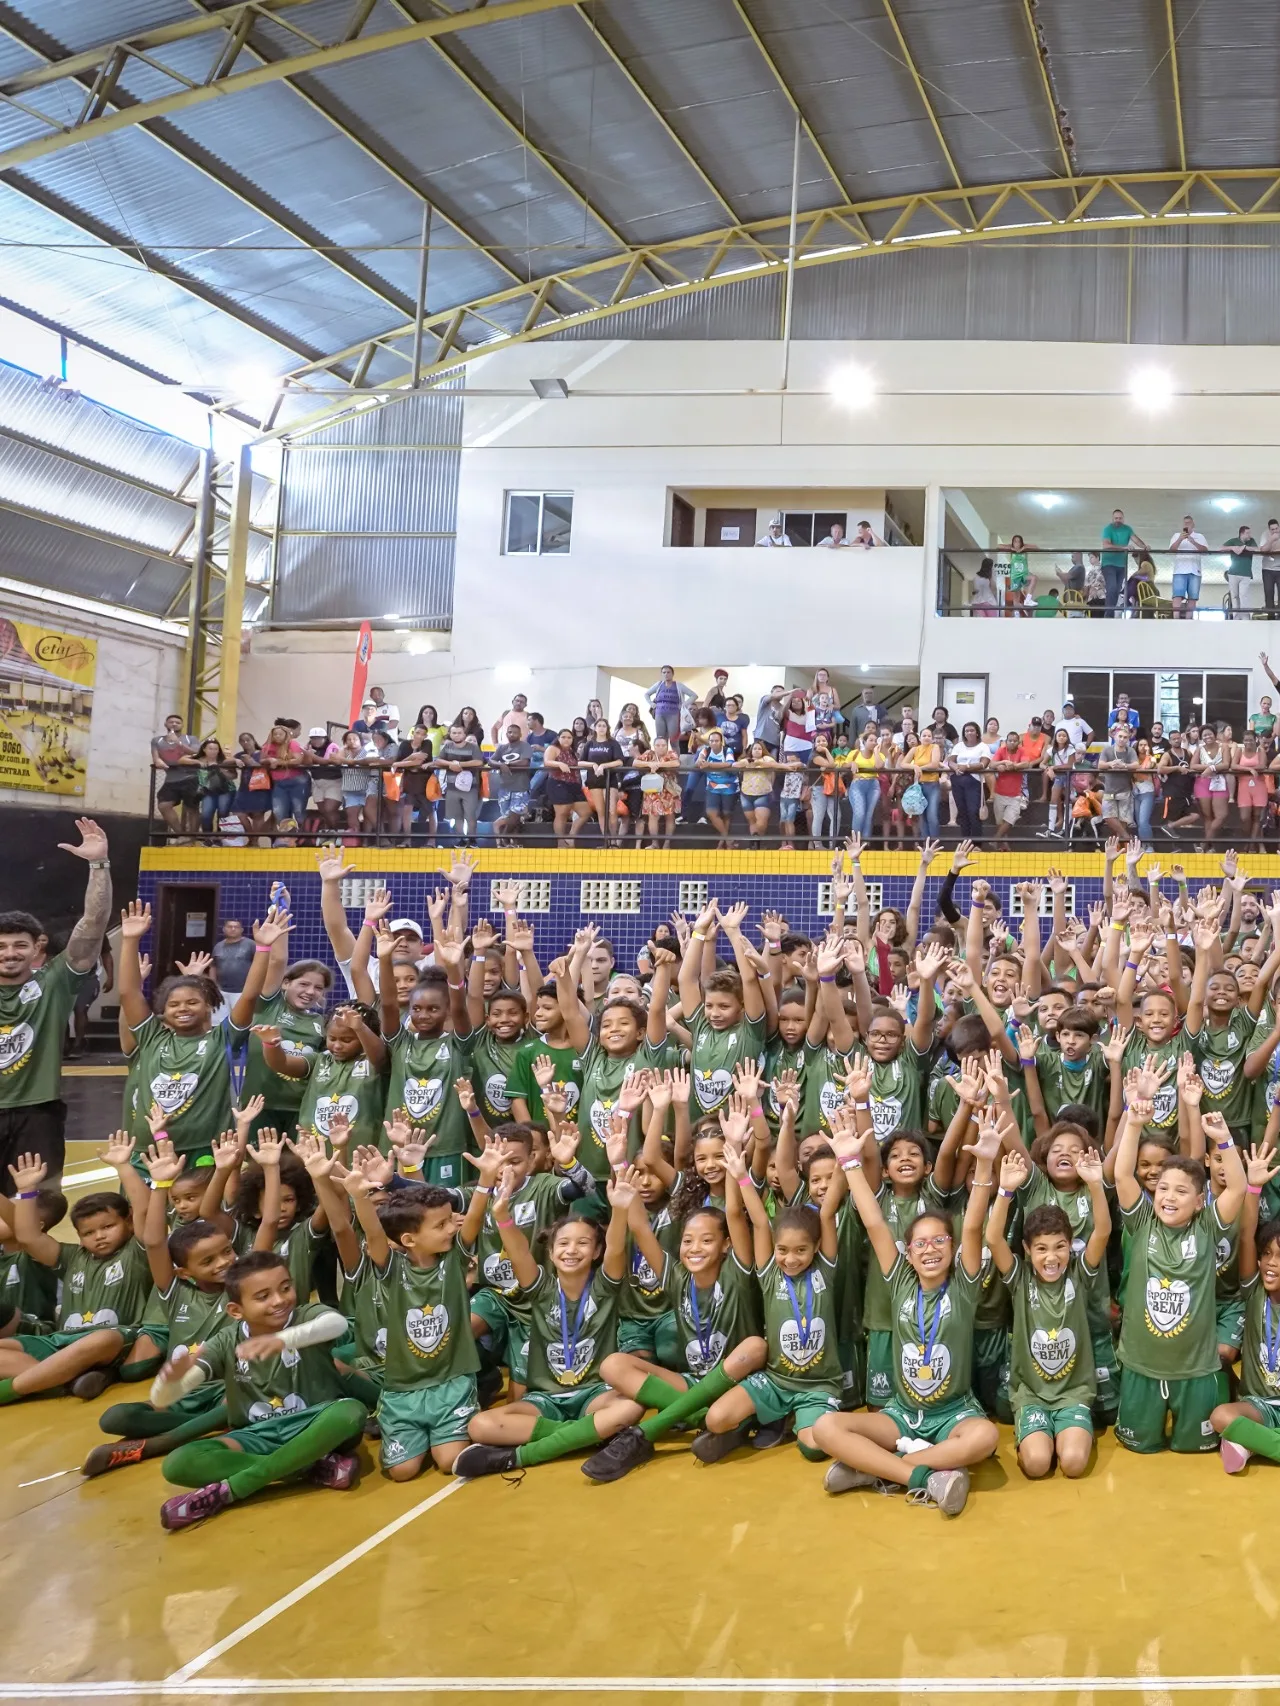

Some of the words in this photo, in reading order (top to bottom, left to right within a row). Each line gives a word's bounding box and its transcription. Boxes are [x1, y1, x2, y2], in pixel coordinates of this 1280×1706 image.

[35, 635, 95, 662] Cetaf
[409, 1096, 434, 1106] BEM
[1153, 1100, 1172, 1112] EM
[873, 1114, 896, 1126] EM
[493, 1270, 516, 1281] BE
[1152, 1300, 1183, 1316] BEM
[413, 1324, 444, 1339] BEM
[790, 1339, 820, 1351] BM
[1033, 1338, 1070, 1351] ESPORTE
[557, 1354, 586, 1365] BM
[1039, 1348, 1070, 1360] BEM
[909, 1366, 942, 1381] BM
